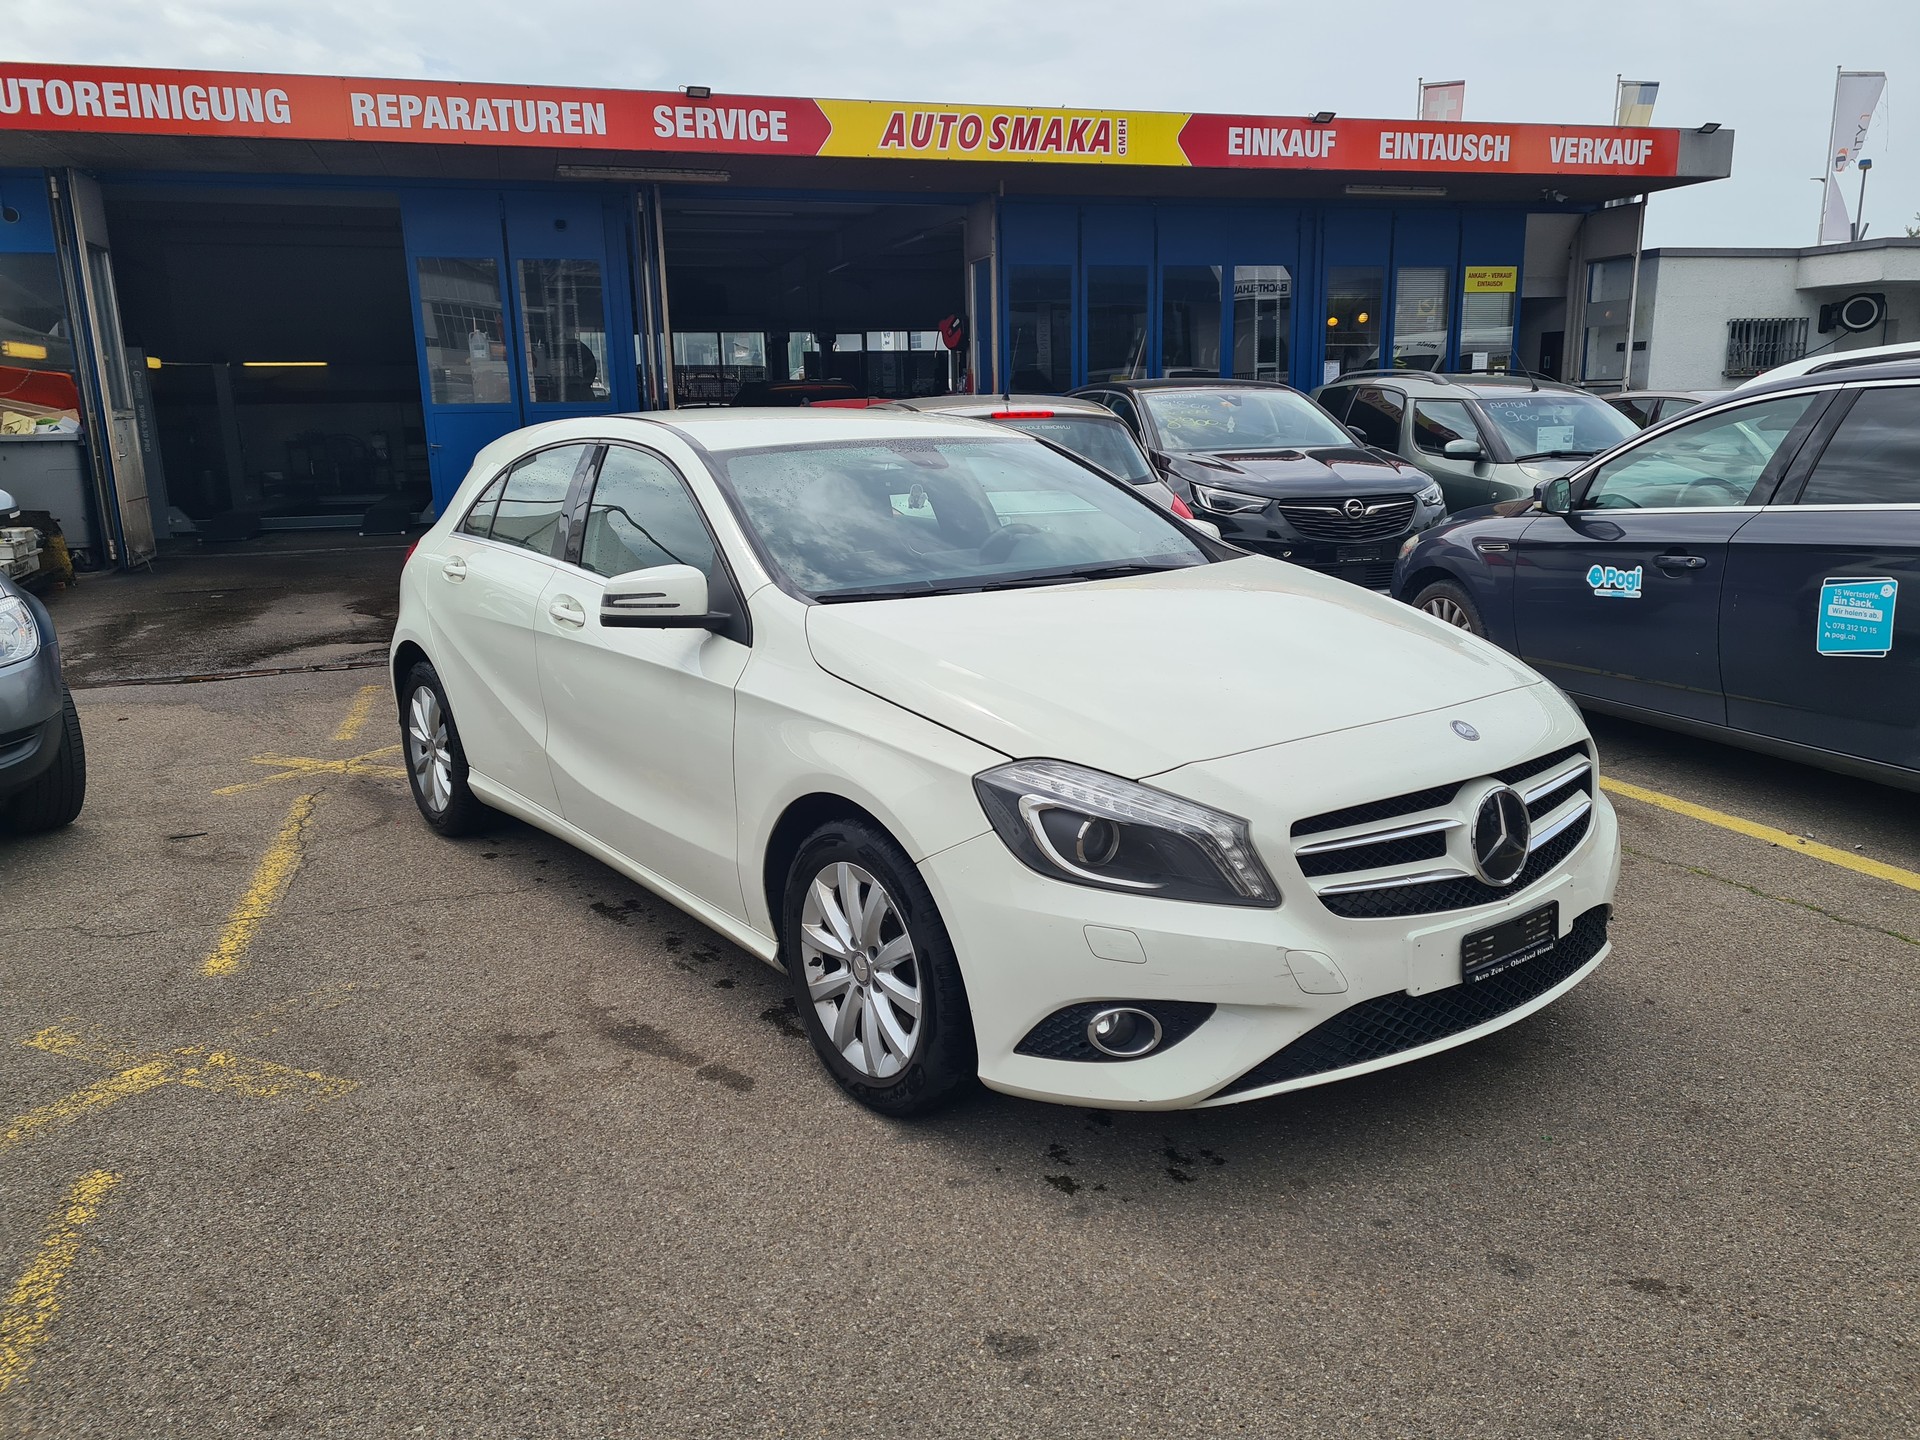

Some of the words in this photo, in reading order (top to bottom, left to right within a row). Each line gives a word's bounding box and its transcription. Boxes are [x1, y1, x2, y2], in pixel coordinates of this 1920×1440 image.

[350, 92, 607, 136] REPARATUREN
[652, 104, 788, 142] SERVICE
[879, 110, 984, 150] AUTO
[987, 114, 1112, 154] SMAKA
[1117, 118, 1128, 155] GMBH
[1228, 126, 1337, 158] EINKAUF
[1379, 131, 1510, 163] EINTAUSCH
[1549, 136, 1654, 166] VERKAUF
[1605, 567, 1641, 591] Pogi
[1833, 596, 1847, 605] Ein
[1849, 598, 1874, 608] Sack.
[1843, 589, 1880, 600] Wertstoffe.
[1832, 622, 1845, 630] 078
[1846, 623, 1858, 632] 312
[1860, 625, 1868, 633] 10
[1869, 626, 1877, 634] 15
[1868, 611, 1879, 619] ab.
[1831, 632, 1856, 641] pogi.ch
